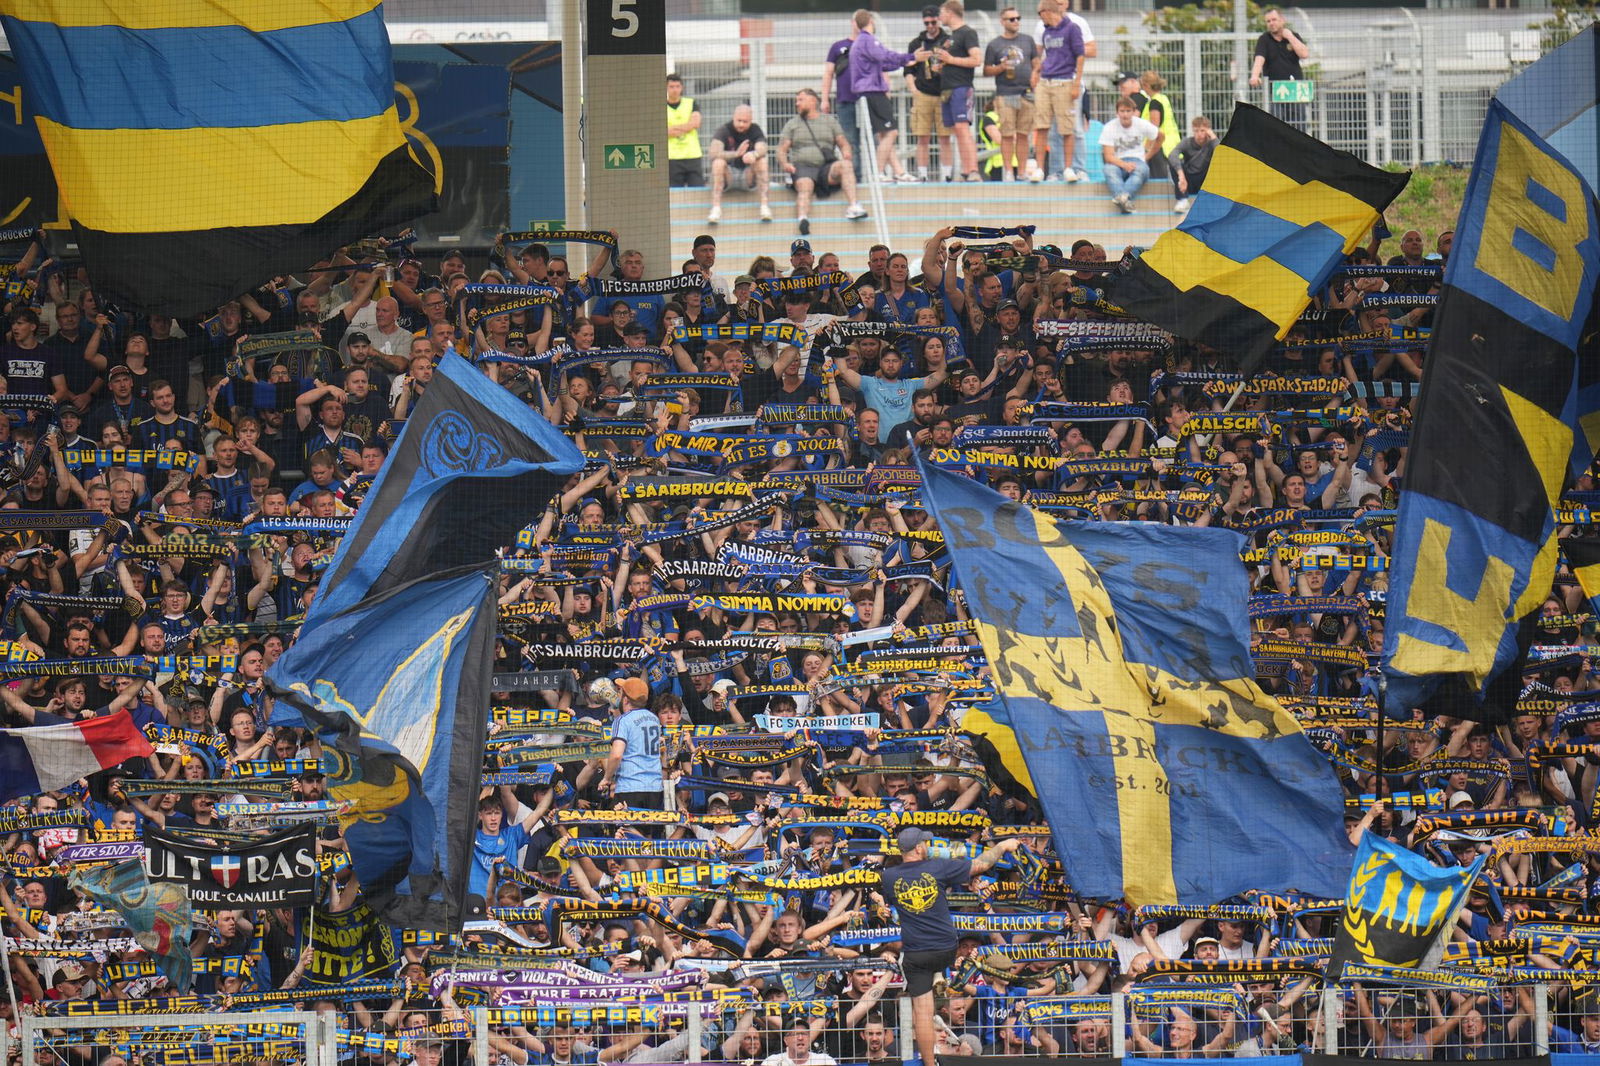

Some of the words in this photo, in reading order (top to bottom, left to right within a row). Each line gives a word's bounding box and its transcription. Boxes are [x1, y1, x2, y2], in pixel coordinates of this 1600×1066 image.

[611, 0, 640, 38] 5
[520, 233, 534, 242] FC
[601, 280, 622, 293] 1.FC
[624, 271, 707, 293] SAARBRÜCKEN
[771, 270, 848, 293] SAARBRÜCKEN
[464, 285, 485, 296] 1.FC
[480, 297, 554, 317] SAARBRÜCKEN
[1362, 297, 1380, 308] 1.FC
[1072, 320, 1158, 338] SEPTEMBER
[646, 376, 660, 386] FC
[686, 435, 718, 453] MIR
[749, 444, 768, 456] ES
[935, 447, 961, 463] DO
[965, 449, 1019, 468] SIMMA
[1067, 462, 1151, 474] HERZBLUT
[1096, 490, 1120, 505] BLUE
[1134, 490, 1168, 500] BLACK
[1178, 490, 1212, 502] ARMY
[10, 515, 90, 527] SAARBRÜCKEN
[261, 517, 282, 528] 1.FC
[719, 596, 775, 612] SIMMA
[546, 643, 648, 658] SAARBRÜCKEN
[28, 661, 69, 676] CONTRE
[81, 659, 94, 675] LE
[95, 657, 138, 675] RACISME
[513, 675, 560, 687] JAHRE
[733, 687, 742, 695] 1.
[744, 685, 758, 693] FC
[763, 717, 783, 730] 1.FC
[146, 728, 159, 739] FC
[161, 727, 231, 763] SAARBRÜCKEN
[641, 725, 660, 757] 12
[1545, 739, 1558, 754] Y
[509, 753, 518, 764] 1.
[519, 744, 587, 762] Fussballclub
[1087, 774, 1147, 792] est.
[218, 803, 268, 815] SARRE
[28, 813, 43, 829] LE
[43, 809, 86, 827] RACISME
[1419, 815, 1452, 834] ON
[1460, 814, 1476, 825] Y
[69, 844, 97, 859] WIR
[98, 843, 129, 856] SIND
[599, 840, 641, 857] CONTRE
[653, 840, 667, 857] LE
[668, 840, 710, 859] RACISME
[145, 847, 205, 881] ULT
[246, 847, 316, 884] RAS
[1546, 887, 1580, 901] FC
[564, 898, 599, 912] ON
[608, 898, 625, 911] Y
[987, 914, 1000, 931] LE
[1000, 914, 1046, 932] RACISME
[1515, 907, 1547, 922] ON
[1555, 911, 1569, 923] Y
[1004, 942, 1046, 960] CONTRE
[1059, 941, 1072, 960] LE
[1073, 940, 1114, 960] RACISME
[1154, 959, 1193, 971] ON
[1202, 959, 1218, 971] Y
[1272, 957, 1305, 970] FC
[1346, 965, 1384, 977] BOYS
[1391, 968, 1489, 988] SAARBRÜCKEN
[262, 992, 289, 1002] WIRD
[1029, 1003, 1064, 1018] BOYS
